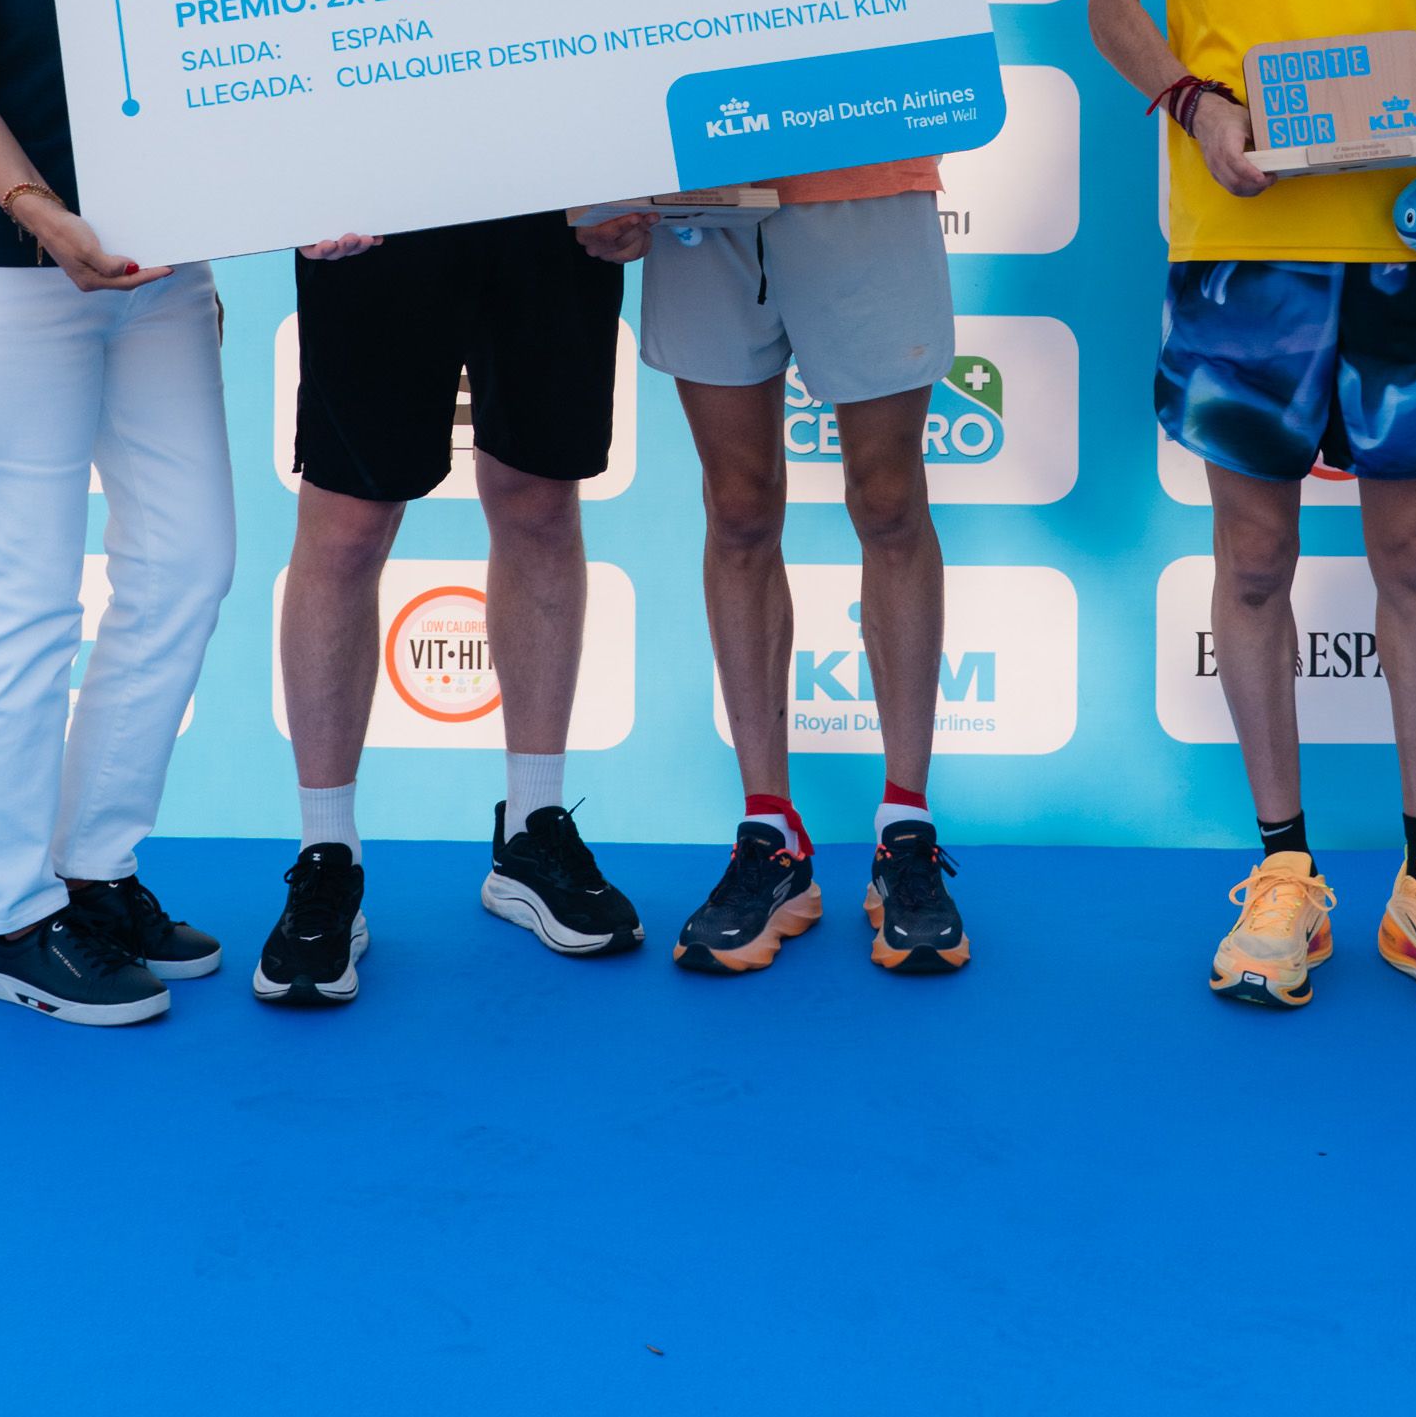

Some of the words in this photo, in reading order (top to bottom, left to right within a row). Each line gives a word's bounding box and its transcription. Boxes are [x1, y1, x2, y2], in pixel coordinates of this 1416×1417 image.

[181, 40, 282, 72] SALIDA:
[331, 16, 434, 52] ESPAÑA
[186, 73, 314, 110] LLEGADA:
[336, 49, 483, 88] CUALQUIER
[488, 33, 598, 68] DESTINO
[603, 0, 849, 52] INTERCONTINENTAL
[1261, 48, 1367, 82] NORTE
[705, 113, 770, 139] KLM
[782, 104, 835, 129] Royal
[839, 97, 897, 120] Dutch
[901, 87, 975, 111] Airlines
[1266, 86, 1304, 114] VS
[904, 111, 948, 130] Travel
[951, 107, 978, 124] Well
[1271, 115, 1332, 146] SUR
[785, 413, 994, 456] CERO
[421, 620, 444, 633] LOW
[794, 713, 848, 734] Royal
[935, 715, 996, 732] irlines
